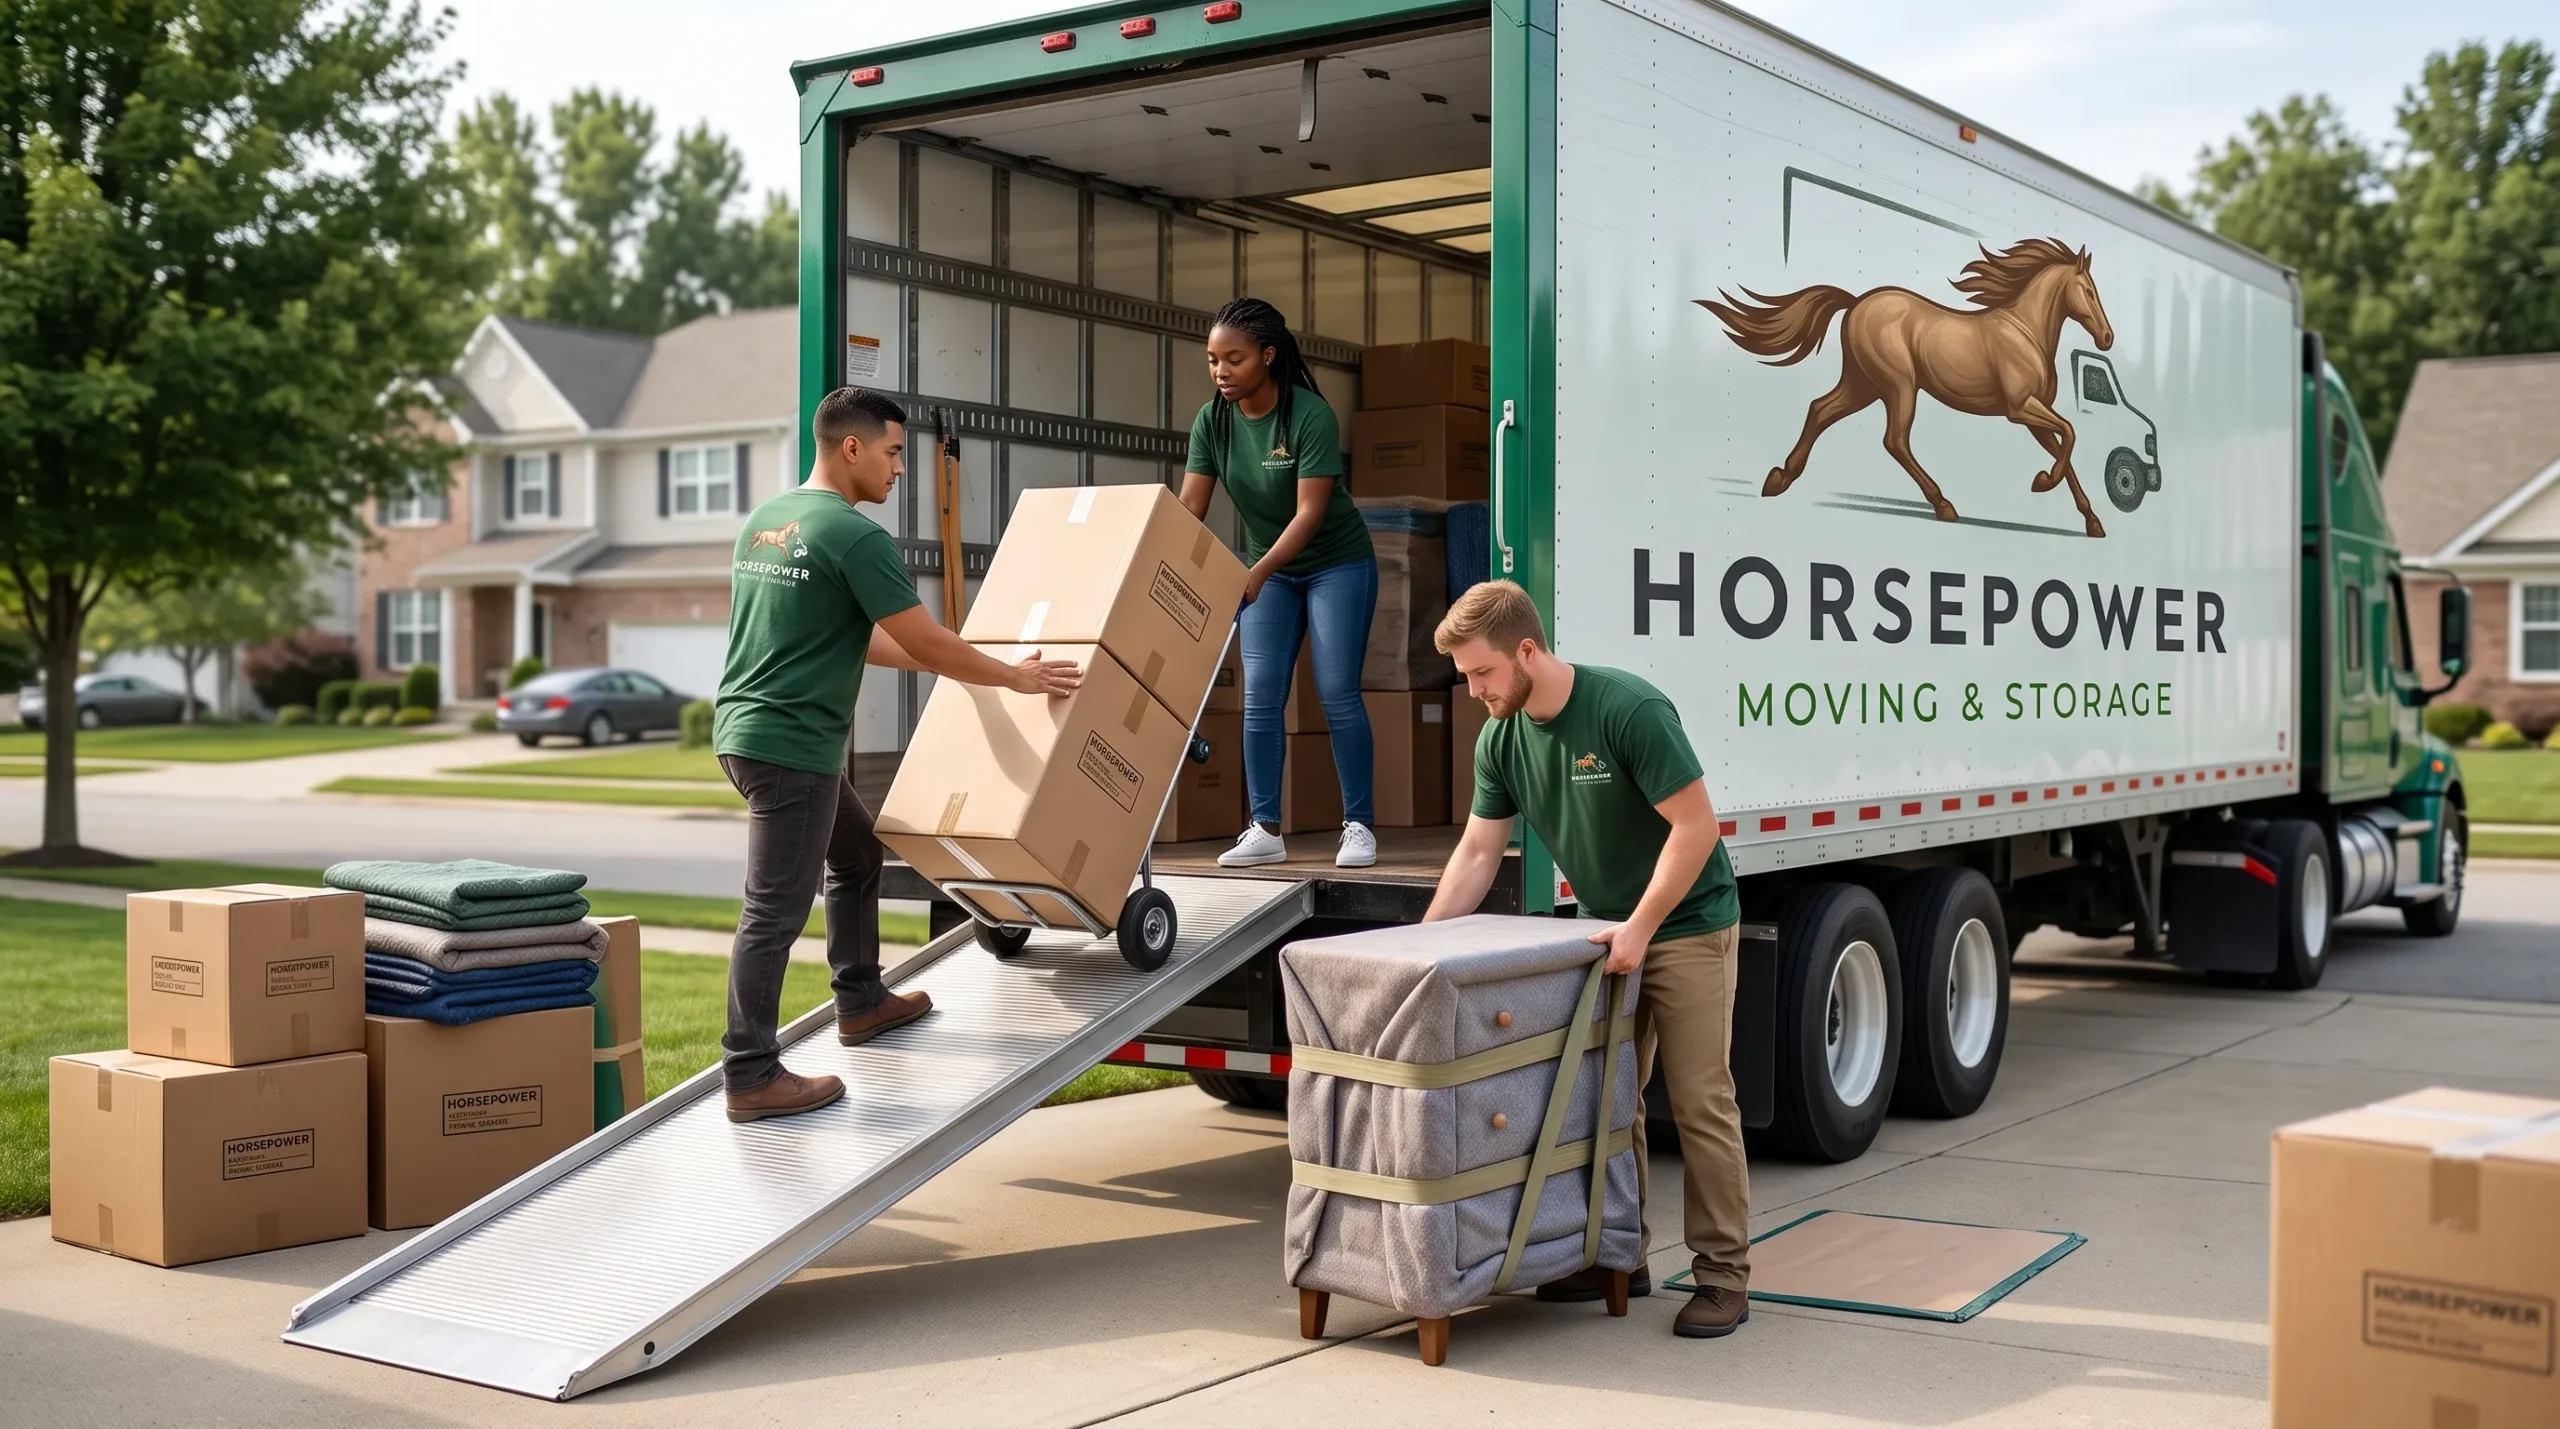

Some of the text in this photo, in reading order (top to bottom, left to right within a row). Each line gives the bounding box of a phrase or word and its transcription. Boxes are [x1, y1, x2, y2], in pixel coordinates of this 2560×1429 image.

[734, 560, 810, 581] HORSEPOWER
[1633, 548, 2227, 654] HORSEPOWER
[1738, 682, 2173, 728] MOVING & STORAGE
[447, 1090, 537, 1110] HORSEPOWER
[227, 1134, 310, 1155] HORSEPOWER
